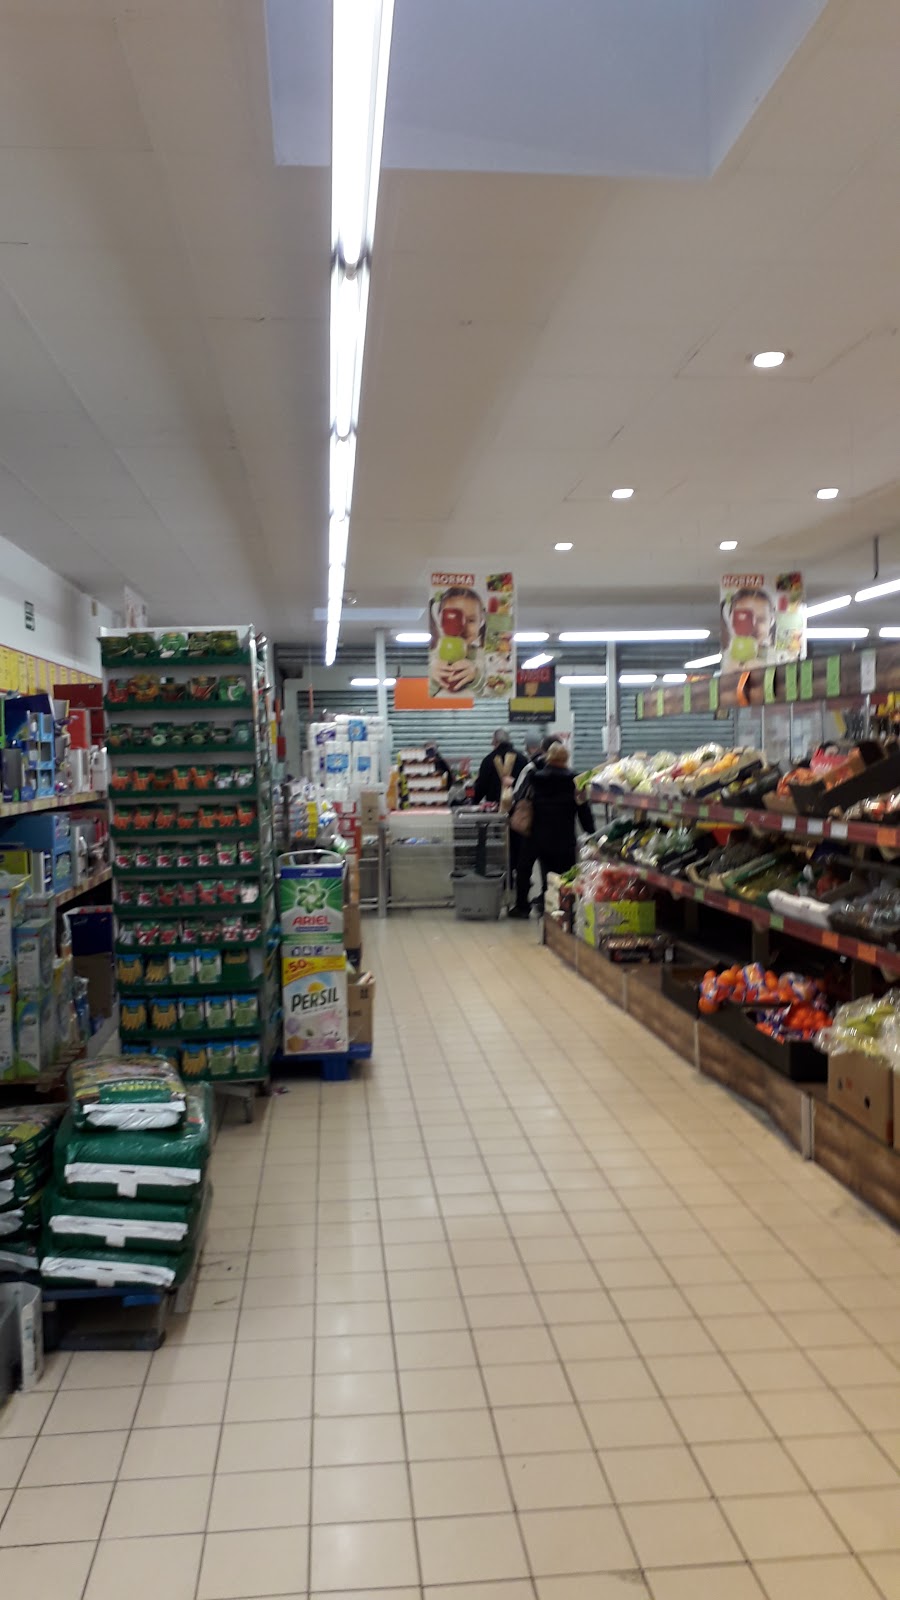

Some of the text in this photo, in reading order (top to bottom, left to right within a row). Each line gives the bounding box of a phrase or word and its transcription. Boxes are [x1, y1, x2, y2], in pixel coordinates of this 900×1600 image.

[432, 573, 474, 585] NORMA
[722, 575, 764, 588] NORMA
[292, 916, 331, 926] ARIEL
[291, 987, 340, 1012] PERSIL
